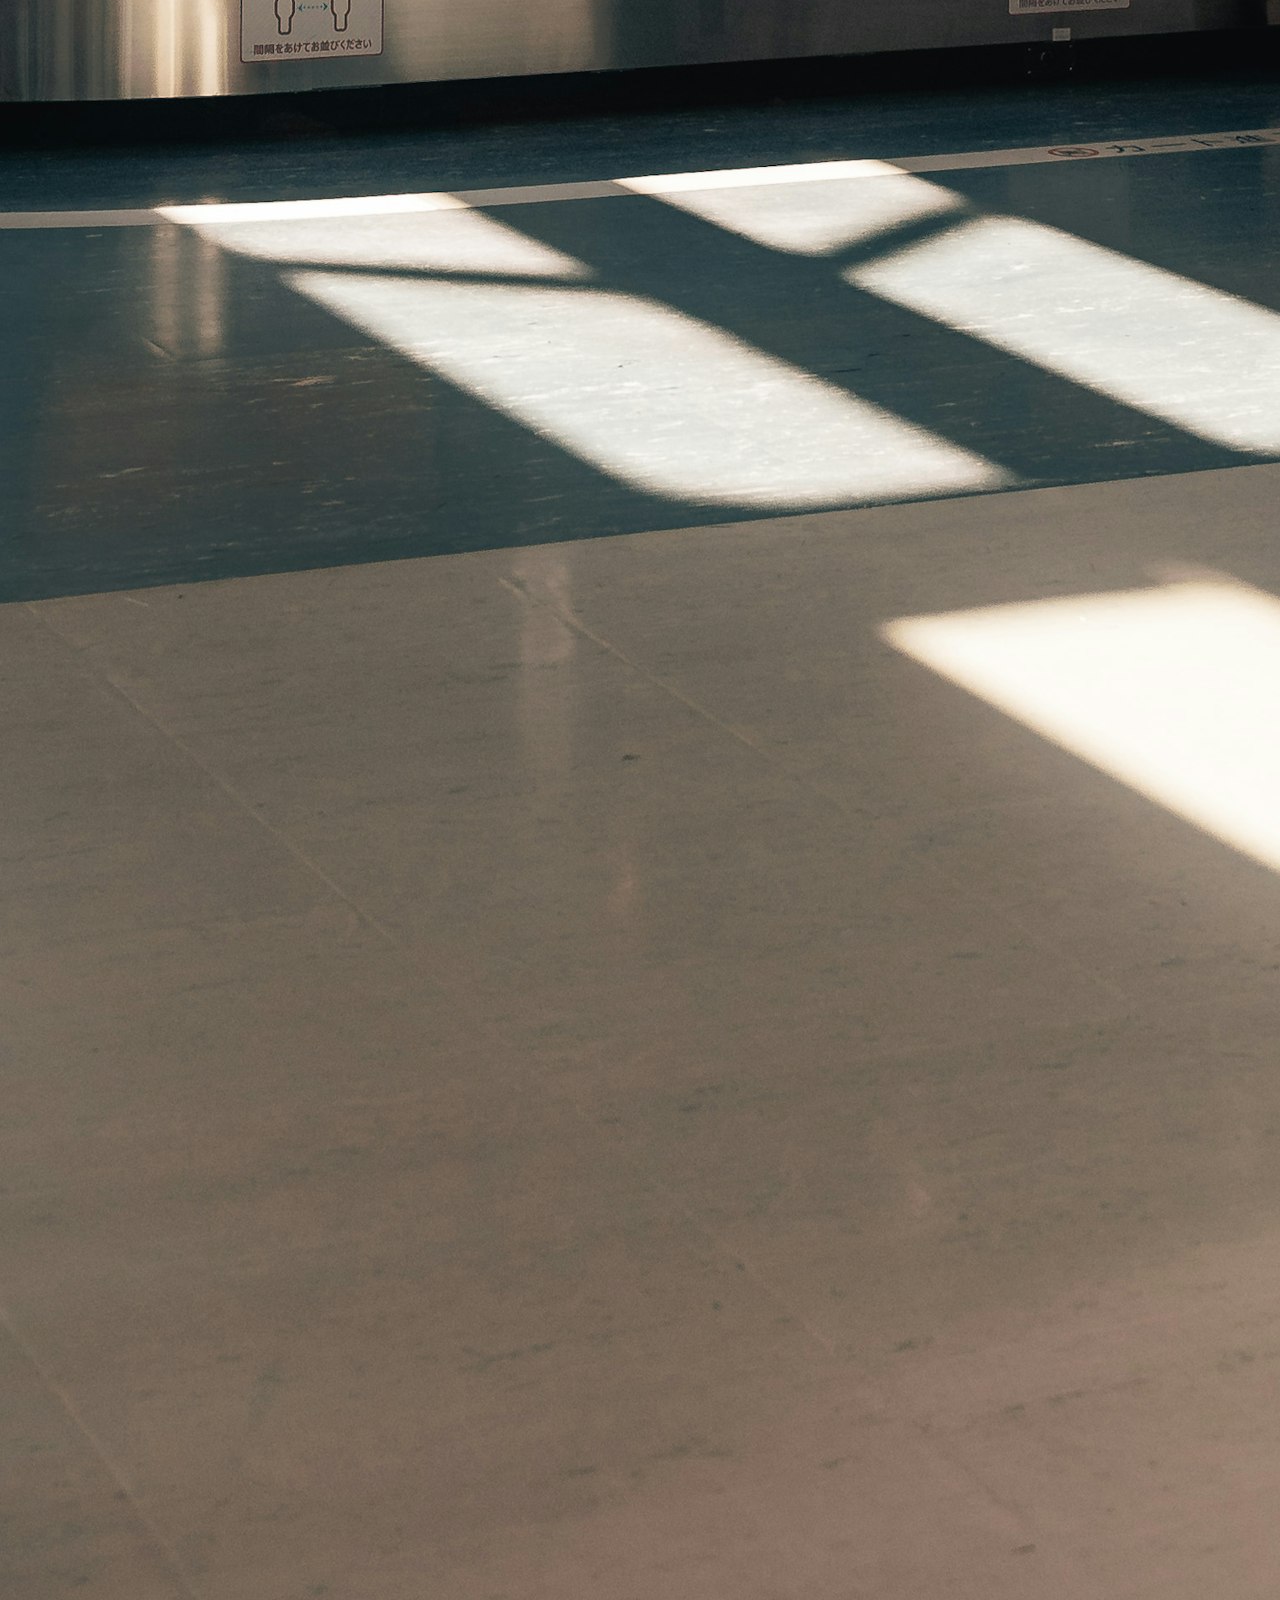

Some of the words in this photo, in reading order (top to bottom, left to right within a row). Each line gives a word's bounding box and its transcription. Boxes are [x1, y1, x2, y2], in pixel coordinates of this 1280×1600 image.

[252, 39, 373, 56] 間隔をあけてお並びください
